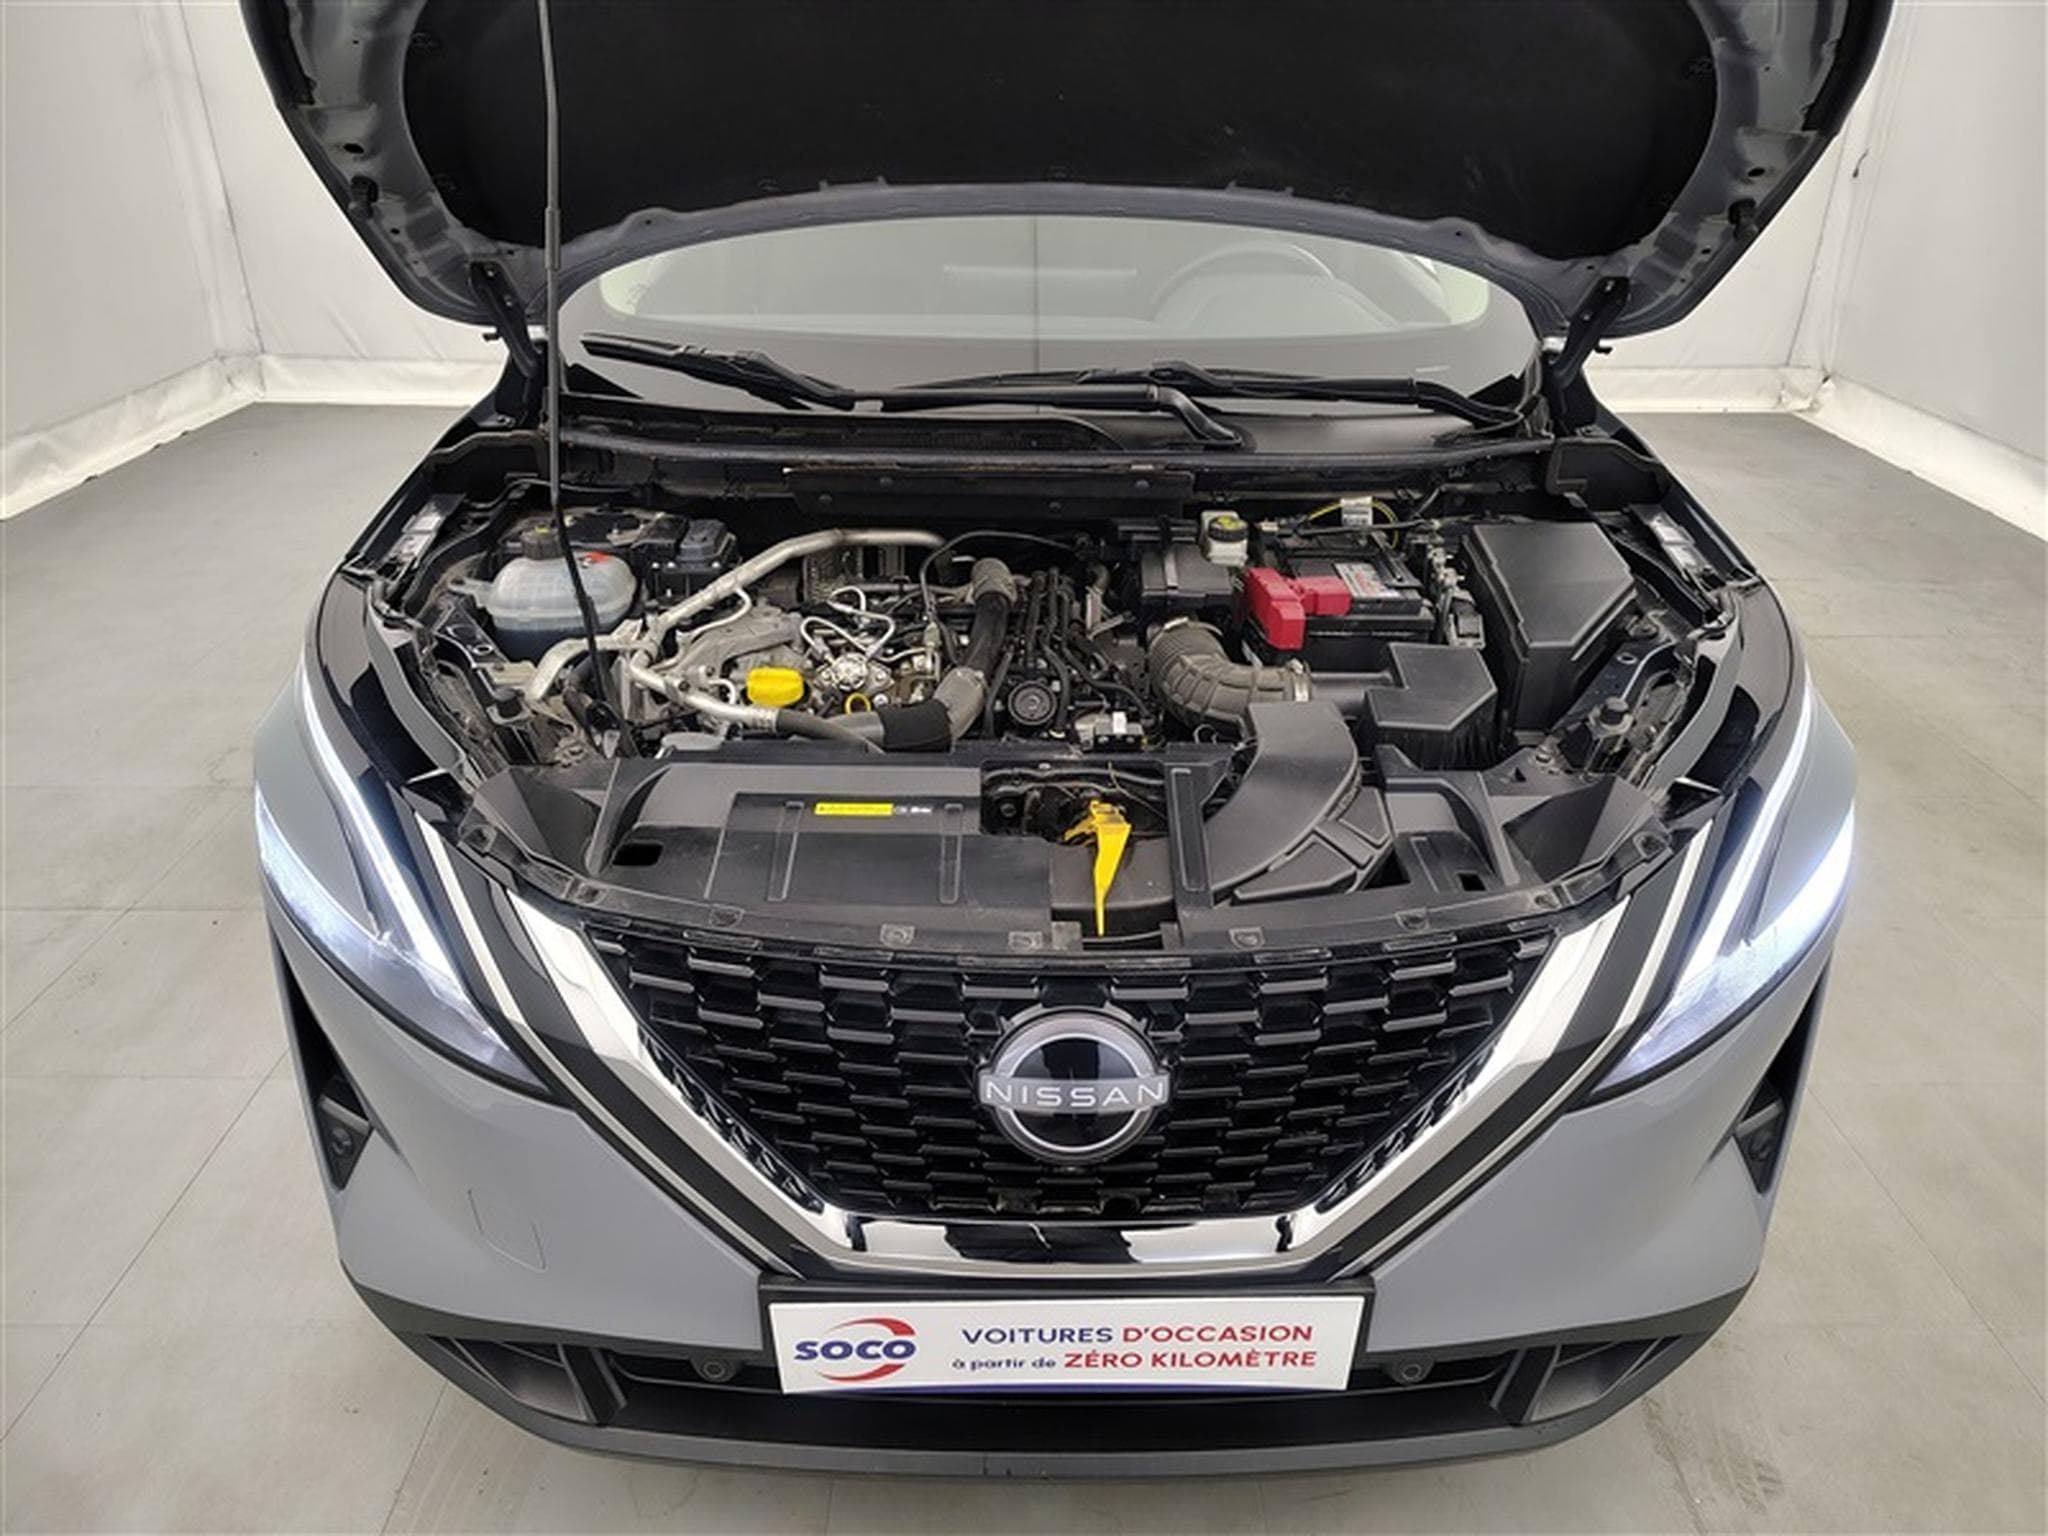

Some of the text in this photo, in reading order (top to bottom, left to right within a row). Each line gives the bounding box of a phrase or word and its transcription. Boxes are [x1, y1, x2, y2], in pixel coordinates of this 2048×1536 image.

[986, 1081, 1163, 1107] NISSAN
[961, 1325, 1313, 1345] VOITURES D'OCCASION
[794, 1339, 917, 1361] SOCO
[970, 1356, 1026, 1372] partir
[1031, 1356, 1056, 1369] de
[1063, 1349, 1143, 1369] ZÉRO
[1151, 1348, 1318, 1368] KILOMÈTRE
